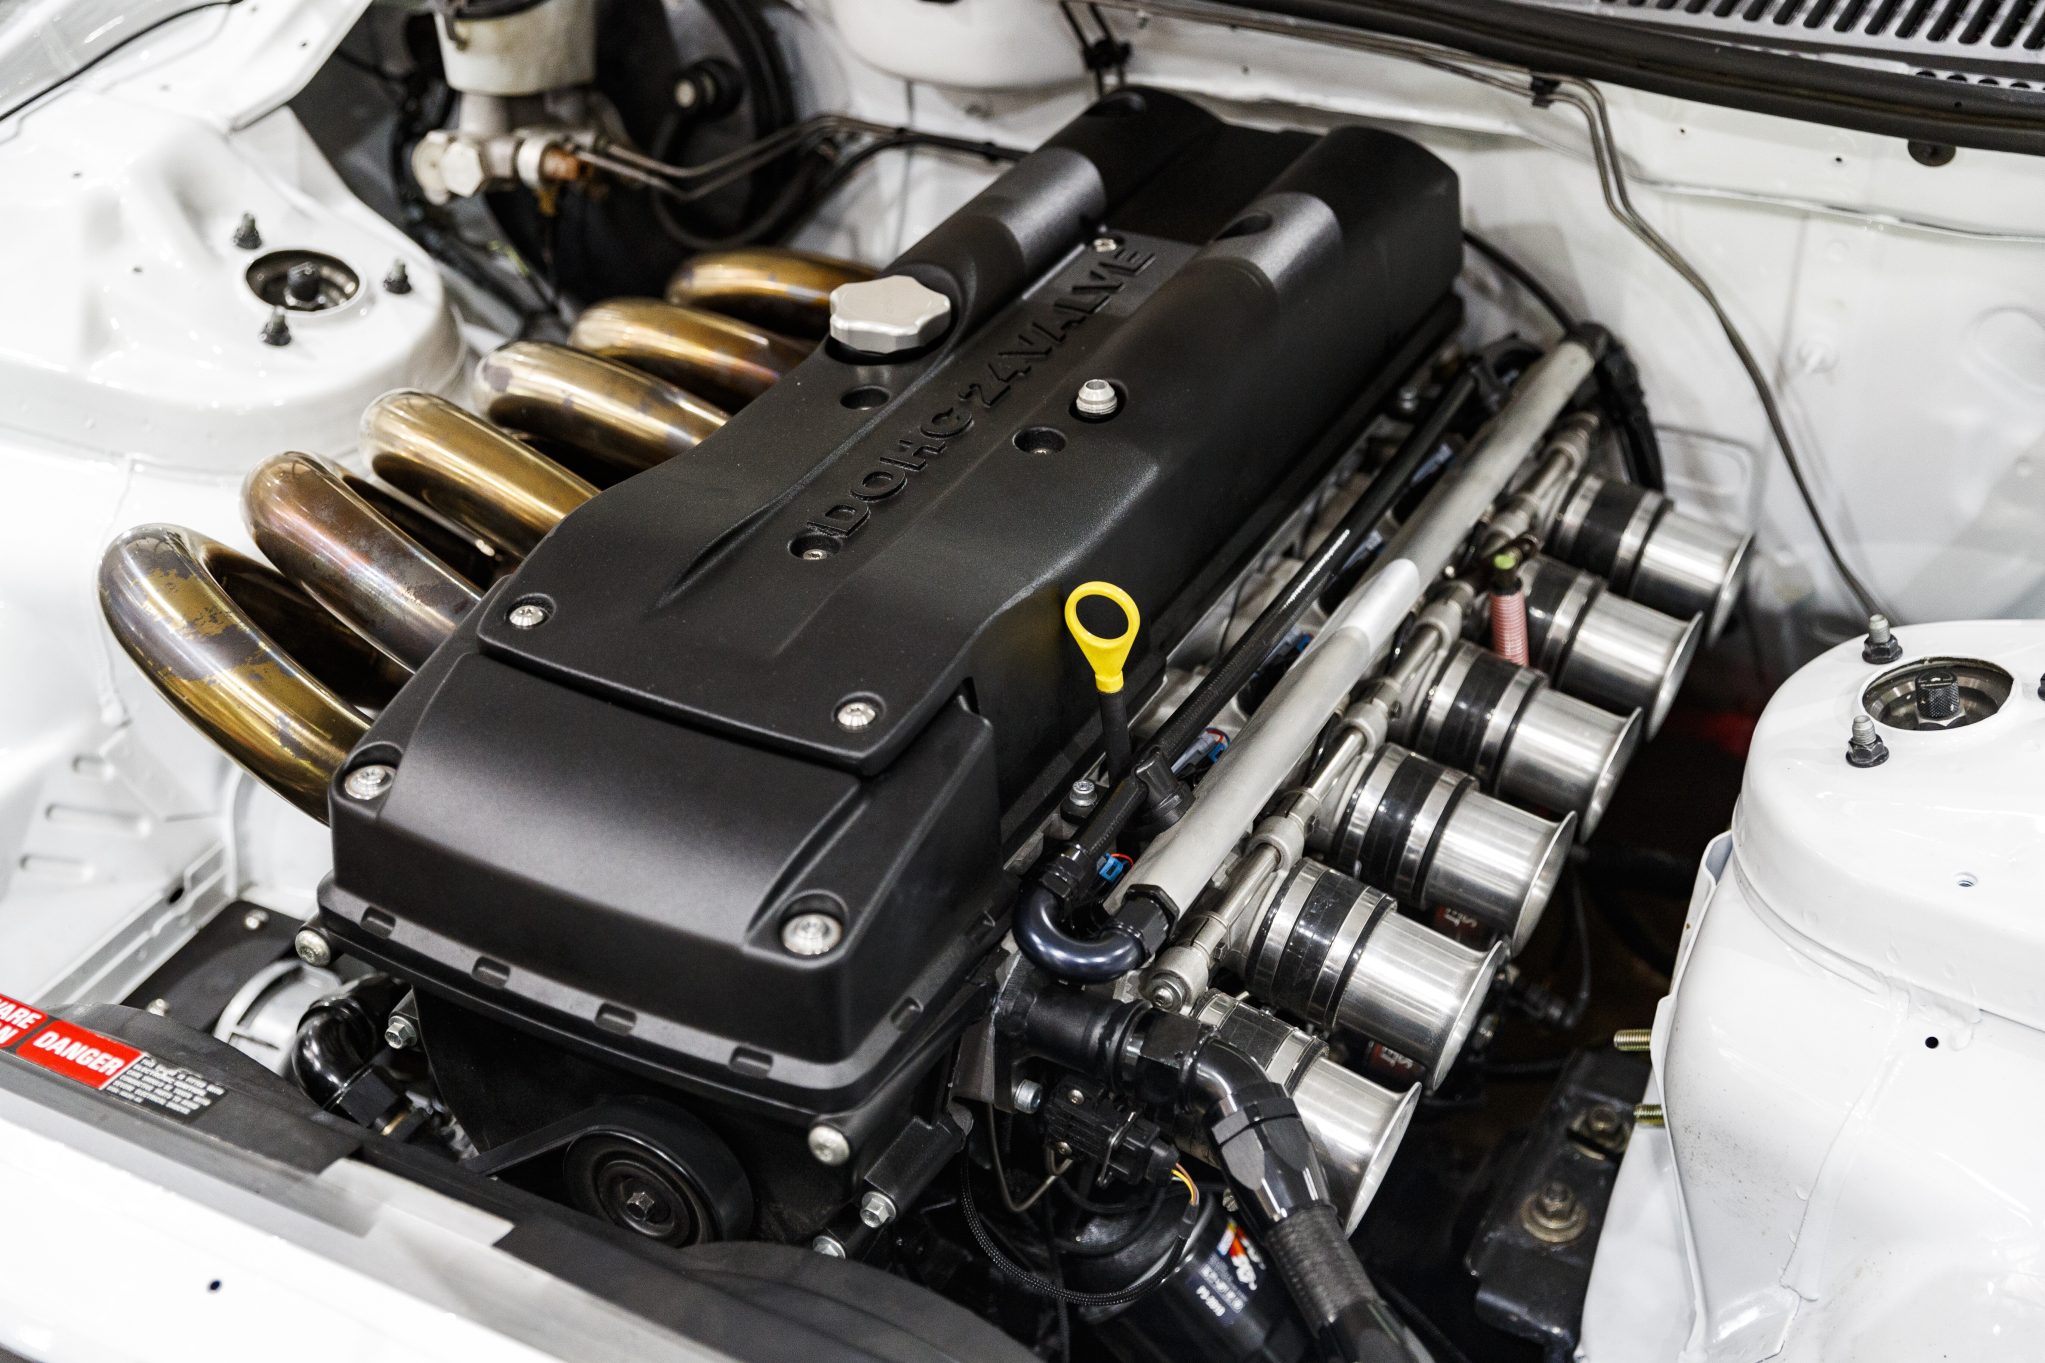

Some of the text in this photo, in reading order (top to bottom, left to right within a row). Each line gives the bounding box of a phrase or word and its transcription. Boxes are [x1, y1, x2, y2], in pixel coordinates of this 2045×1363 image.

[806, 401, 974, 538] DOHC
[0, 1001, 43, 1030] ARE
[32, 1031, 126, 1077] DANGER
